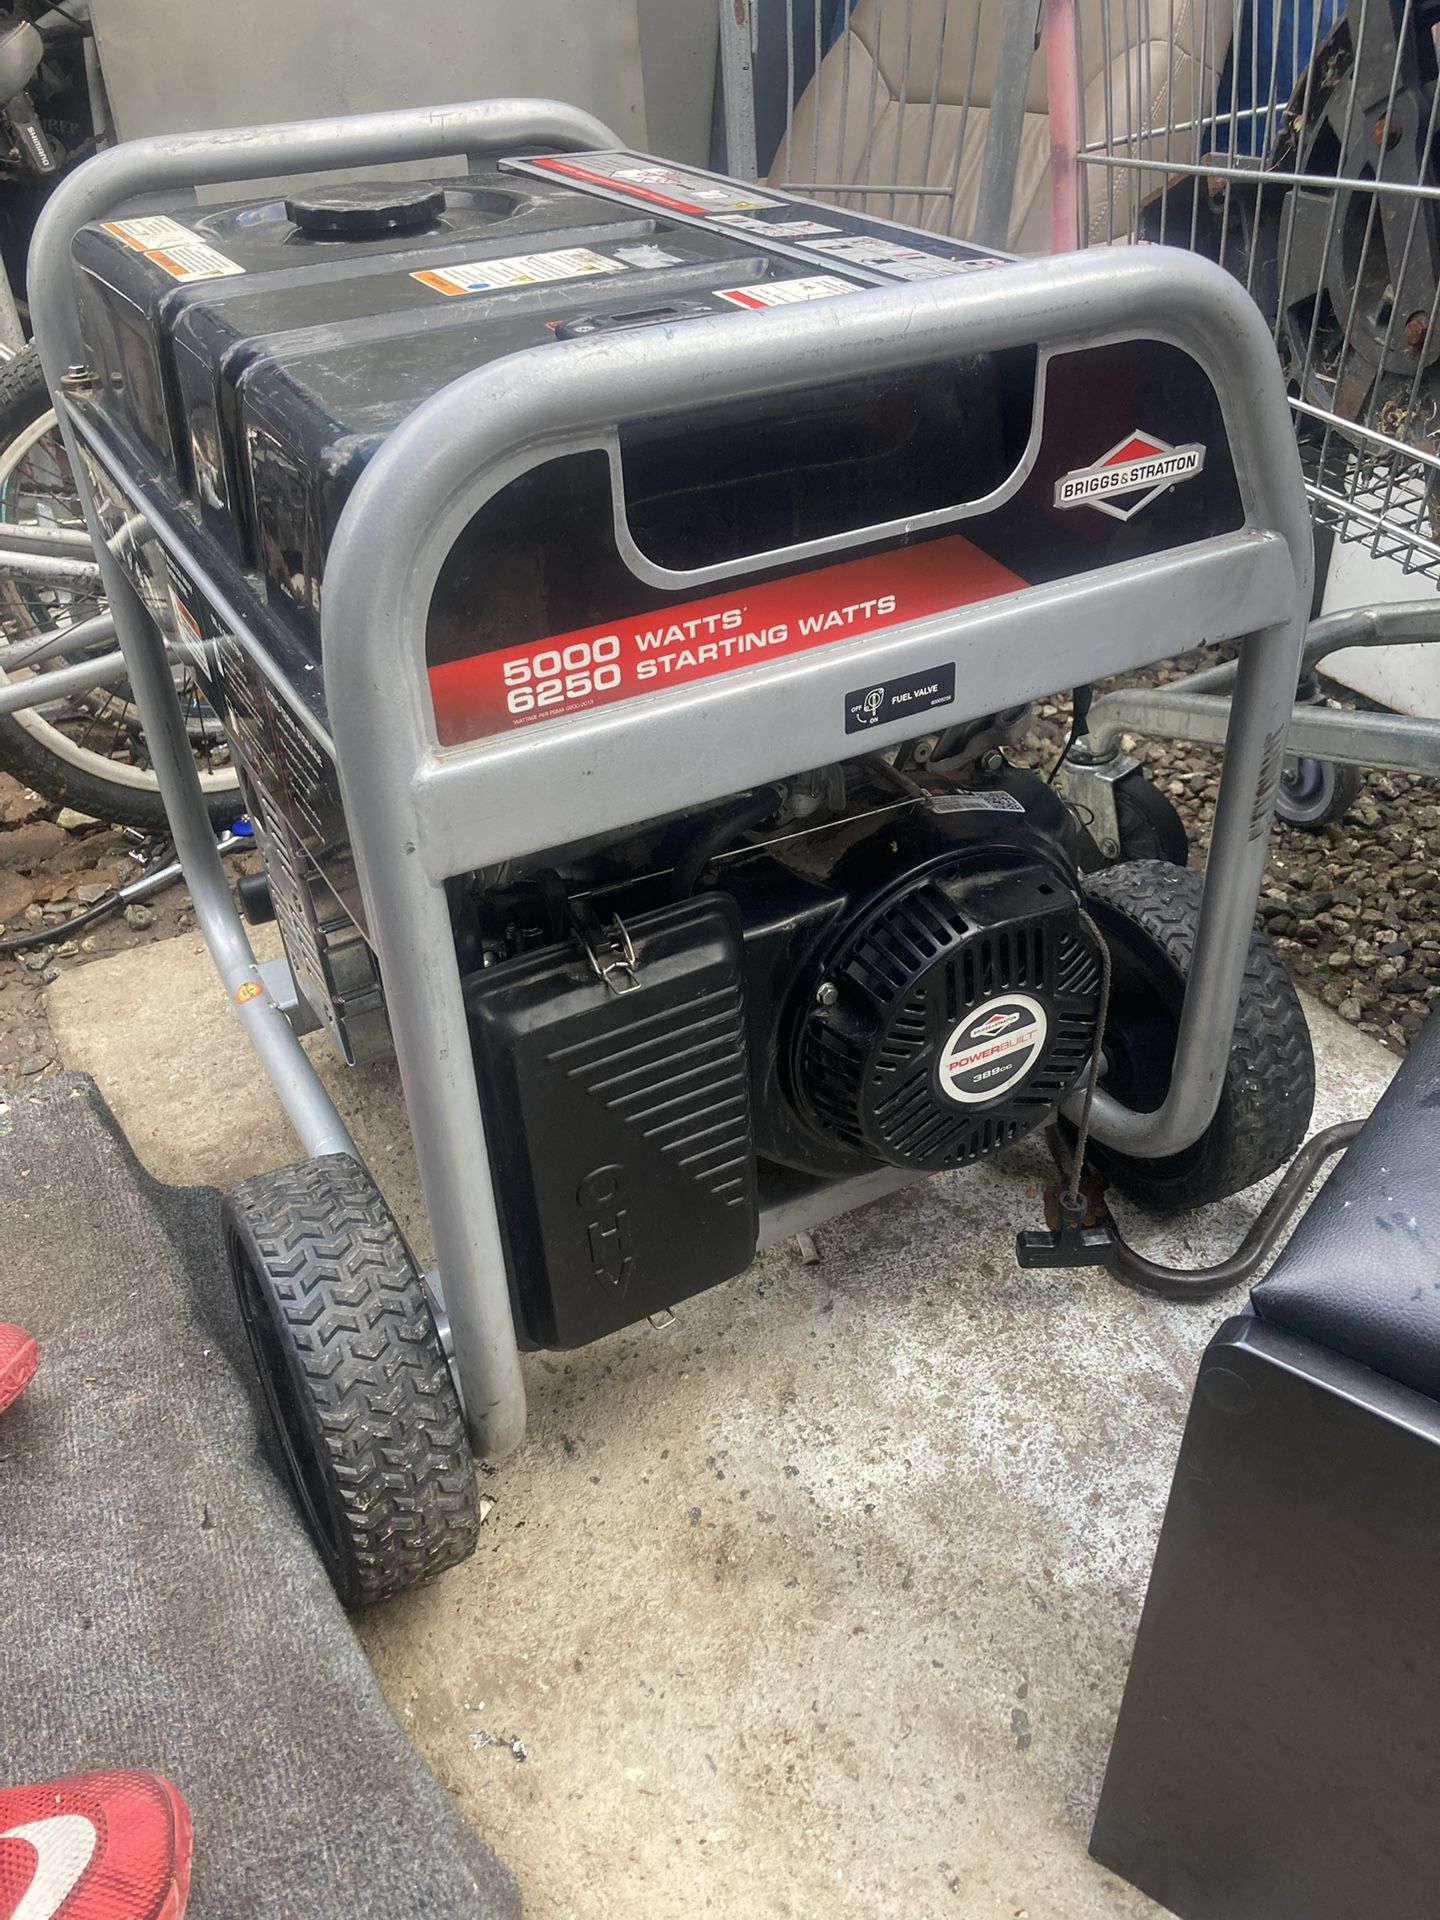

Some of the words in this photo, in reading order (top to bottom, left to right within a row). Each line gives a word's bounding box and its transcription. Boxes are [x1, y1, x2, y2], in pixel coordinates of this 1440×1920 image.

[26, 126, 50, 166] SHIMANO
[1064, 455, 1197, 498] BRIGGS&STRATTON
[503, 635, 620, 686] 5000
[507, 664, 621, 714] 6250
[637, 624, 788, 680] STARTING
[798, 595, 896, 636] WATTS
[851, 705, 863, 713] OFF
[892, 693, 912, 704] FUEL
[914, 684, 938, 698] VALVE
[947, 1029, 1038, 1071] POWERBUILT
